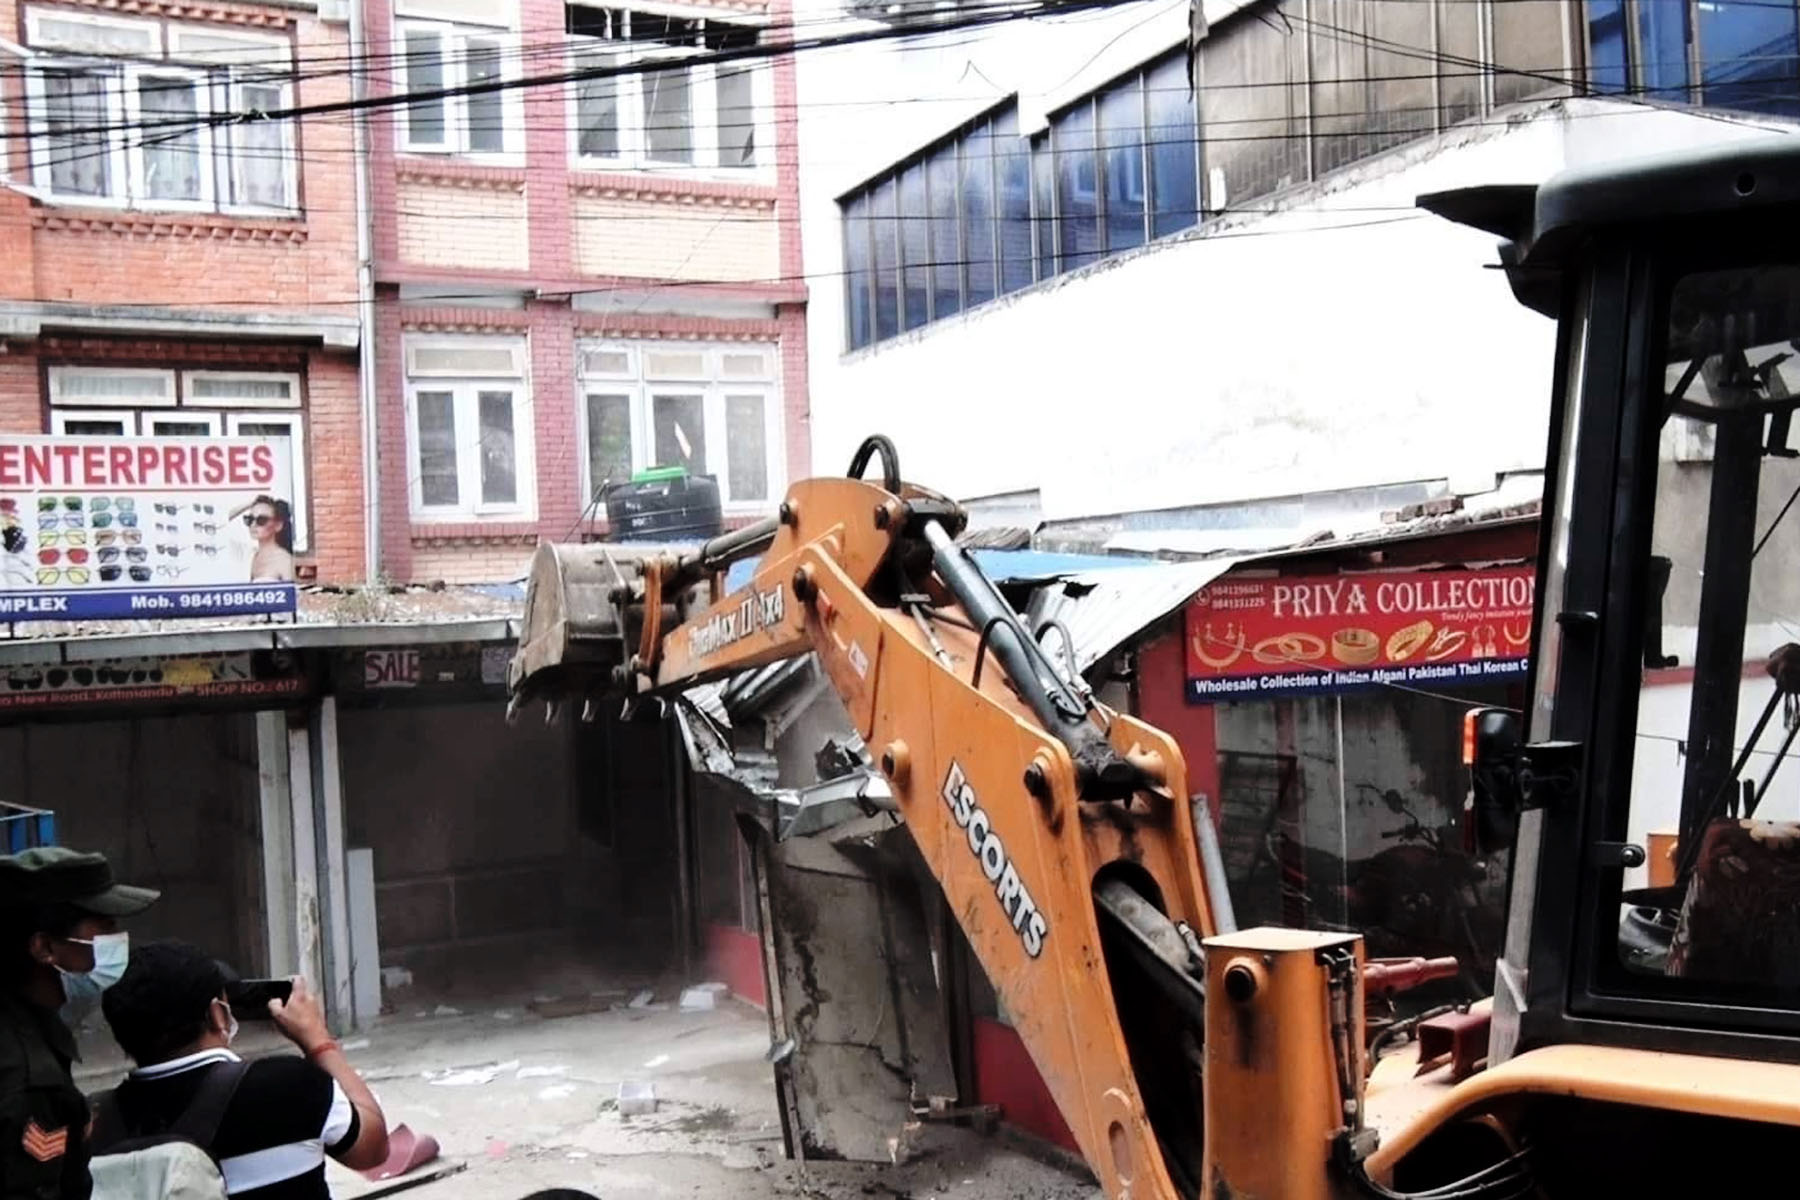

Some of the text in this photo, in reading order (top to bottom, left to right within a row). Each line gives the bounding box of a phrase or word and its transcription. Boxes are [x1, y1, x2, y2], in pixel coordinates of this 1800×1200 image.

[0, 445, 273, 485] ENTERPRISES
[132, 591, 286, 609] Mob. 9841986492
[1272, 578, 1369, 618] PRIYA
[365, 652, 420, 686] SALE
[1196, 677, 1257, 693] Wholesale
[1261, 673, 1318, 690] Collection
[1320, 672, 1334, 686] of
[1335, 670, 1370, 685] Indian
[1372, 668, 1406, 684] Afgani
[1408, 665, 1457, 680] Pakistani
[1459, 662, 1481, 676] Thai
[1484, 659, 1518, 674] Korean
[196, 682, 238, 697] SHOP
[942, 759, 1047, 958] ESCORTS
